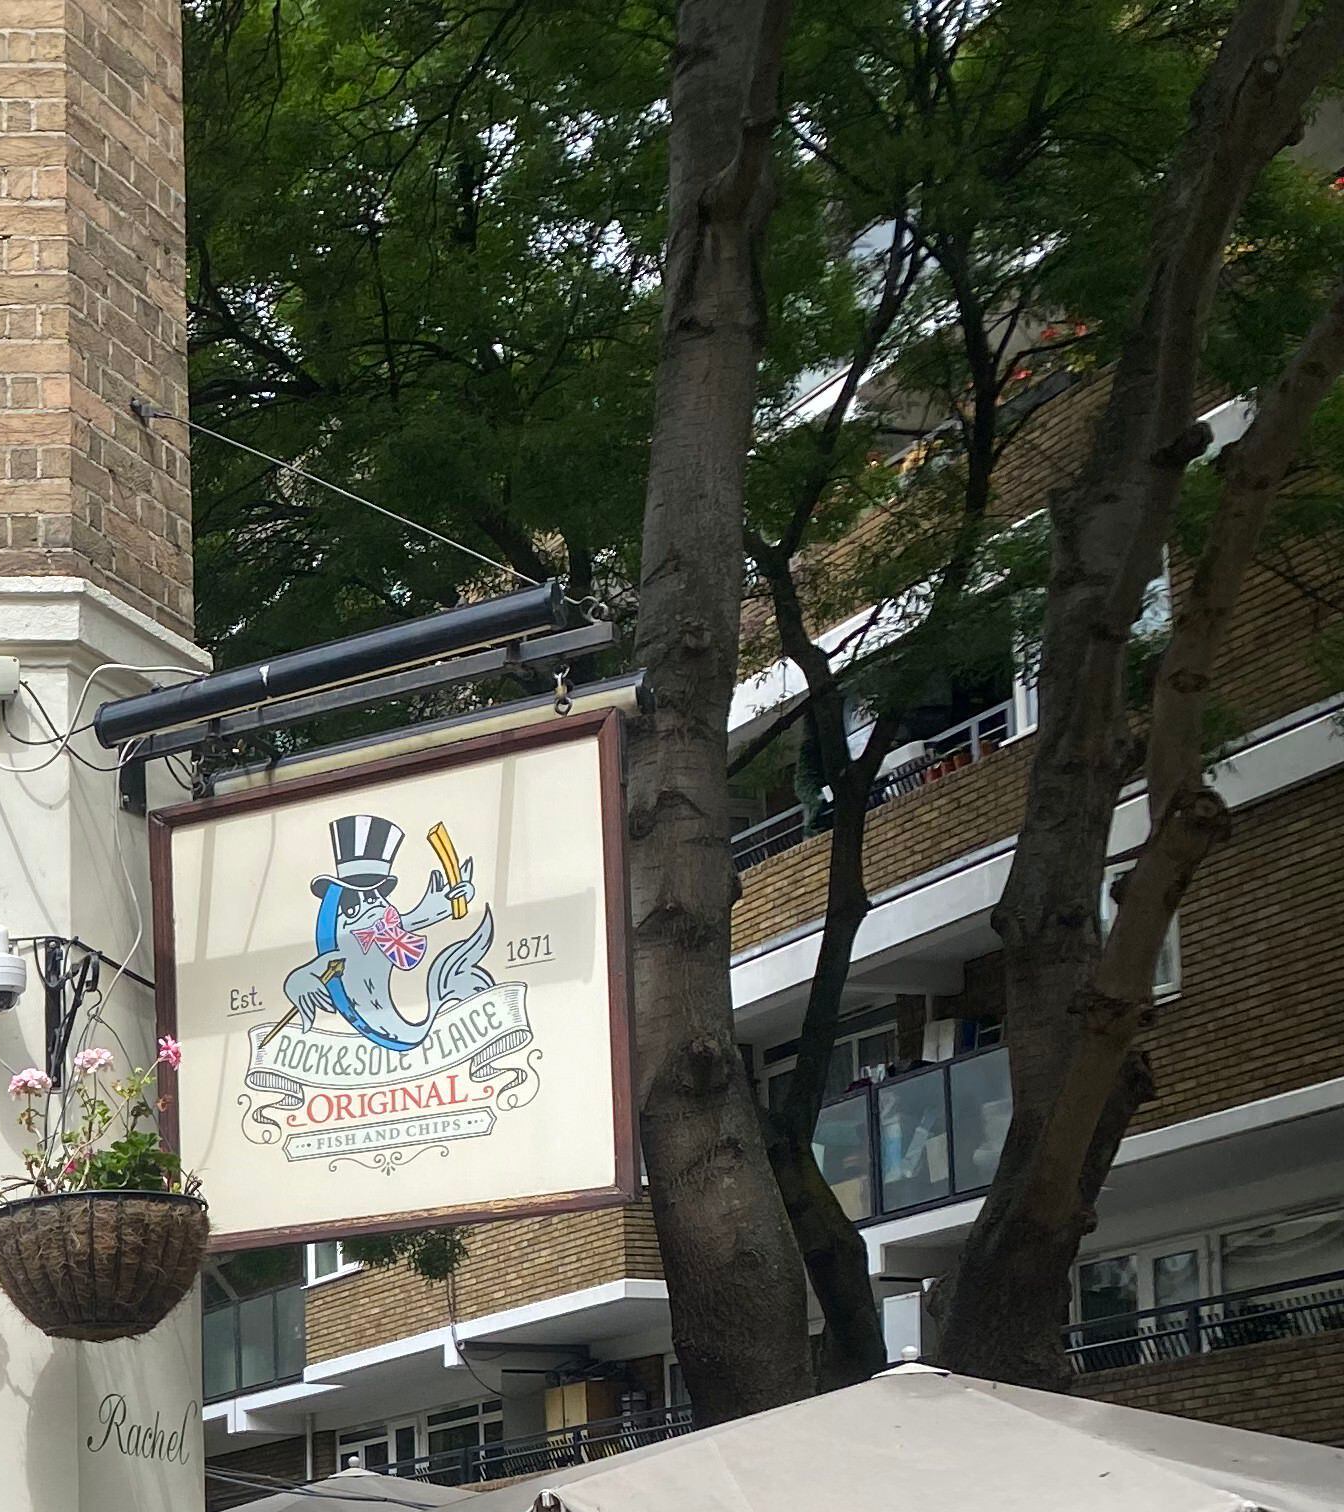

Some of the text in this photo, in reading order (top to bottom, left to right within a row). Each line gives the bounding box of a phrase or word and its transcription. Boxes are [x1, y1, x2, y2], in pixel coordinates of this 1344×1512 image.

[506, 933, 554, 963] 1871
[230, 989, 264, 1011] Est.
[422, 1001, 502, 1065] PLAICE
[307, 1074, 468, 1124] ORIGINAL
[316, 1118, 462, 1150] FISH AND CHIPS
[87, 1393, 197, 1466] Rachel
